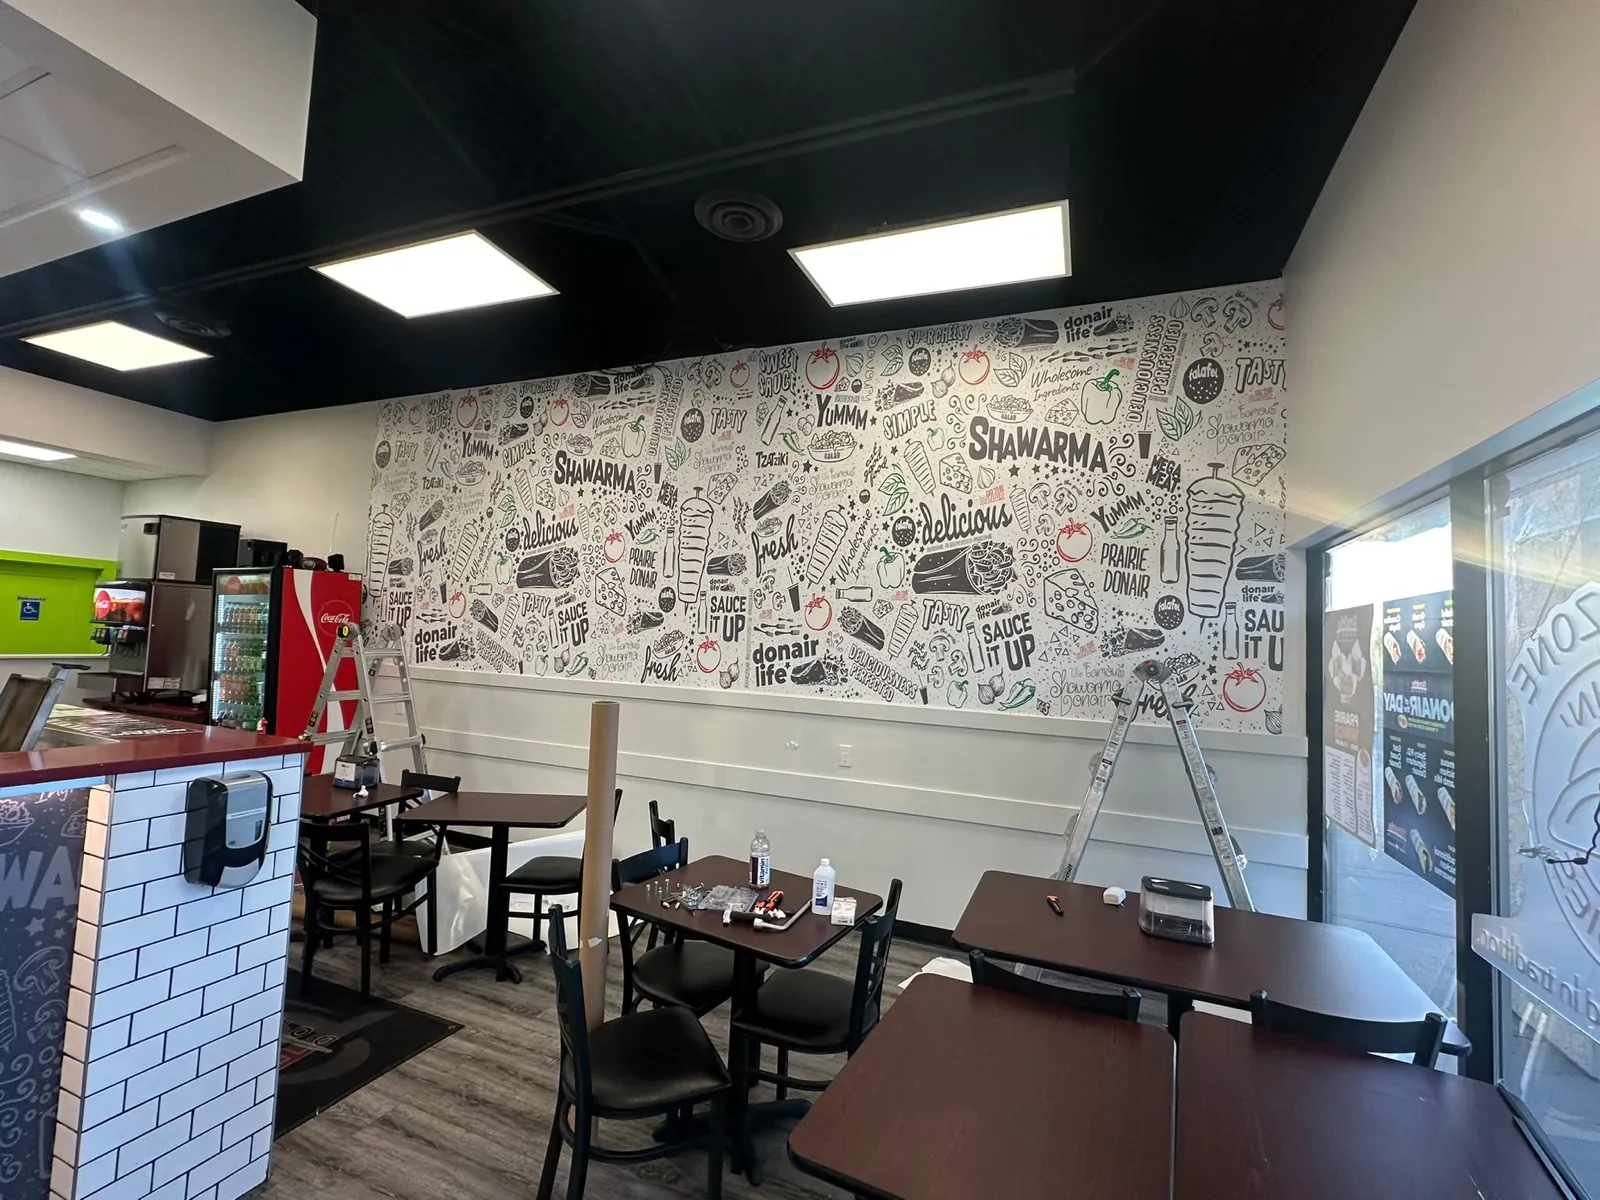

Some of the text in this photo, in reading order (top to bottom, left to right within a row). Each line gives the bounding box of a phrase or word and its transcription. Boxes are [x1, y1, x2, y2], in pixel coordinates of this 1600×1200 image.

[1064, 306, 1113, 330] donair
[1066, 328, 1091, 343] life
[758, 347, 799, 374] SWEET
[1126, 314, 1166, 423] DELICIOUSNESS
[1151, 319, 1184, 396] PERFECTED
[757, 372, 797, 398] SAUCE
[1031, 365, 1093, 389] Wholesome
[1033, 381, 1081, 402] Ingredients
[710, 407, 747, 435] TASTY
[883, 399, 937, 440] SIMPLE
[1206, 413, 1274, 440] Shawarma
[502, 437, 537, 469] SIMPLE
[969, 415, 1108, 474] SHAWARMA
[554, 449, 636, 495] SHAWARMA
[1151, 454, 1181, 477] MEGA
[1146, 469, 1181, 493] MEAT
[522, 510, 579, 550] delicious
[919, 493, 1013, 546] delicious
[417, 526, 447, 577] fresh
[751, 514, 798, 578] fresh
[836, 509, 873, 583] Wholesome
[1101, 543, 1151, 571] PRAIRIE
[630, 568, 658, 589] DONAIR
[1103, 570, 1151, 599] DONAIR
[1241, 585, 1275, 595] donair
[389, 591, 413, 606] SAUCE
[522, 591, 551, 619] TASTY
[710, 595, 747, 613] SAUCE
[975, 599, 1000, 614] donair
[1242, 593, 1259, 603] life
[557, 601, 588, 627] SAUCE
[722, 614, 746, 642] UP
[922, 598, 969, 633] TASTY
[977, 610, 991, 620] life
[415, 621, 457, 646] donair
[571, 617, 590, 647] UP
[982, 612, 1033, 645] SAUCE
[415, 646, 437, 663] life
[753, 633, 819, 665] donair
[1004, 633, 1036, 671] UP
[640, 645, 681, 683] fresh
[755, 662, 787, 687] life
[849, 643, 918, 700] DELICIOUSNESS
[849, 664, 895, 702] PERFECTED
[1050, 669, 1123, 699] Shawarma
